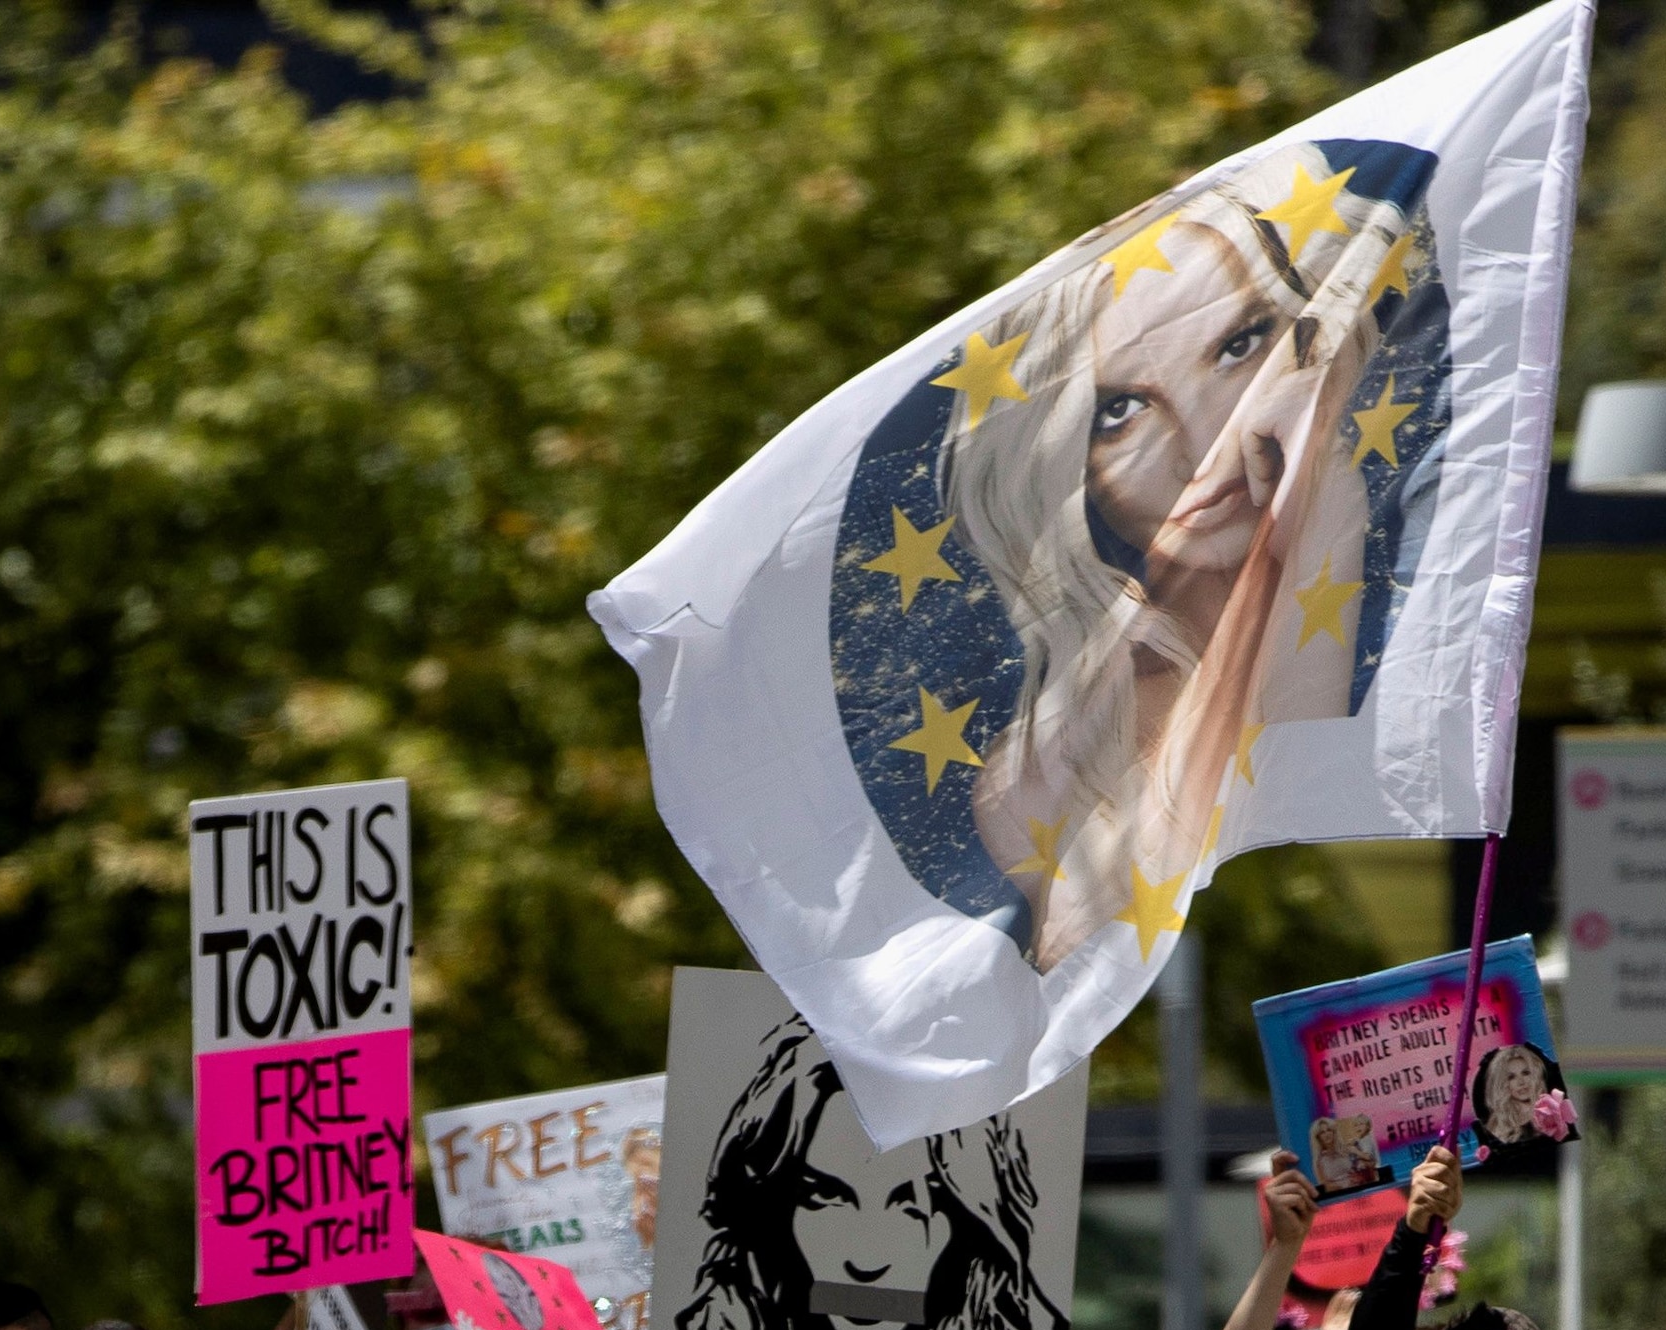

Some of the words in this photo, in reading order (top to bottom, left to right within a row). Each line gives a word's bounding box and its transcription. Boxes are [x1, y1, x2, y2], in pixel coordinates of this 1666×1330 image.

[195, 808, 329, 915] THIS
[345, 804, 398, 908] IS
[200, 902, 404, 1040] TOXIC!
[1314, 1018, 1380, 1051] BRITNEY
[1389, 998, 1451, 1031] SPEARS
[1320, 1038, 1391, 1079] CAPABLE
[1400, 1027, 1448, 1052] ADULT
[253, 1050, 366, 1141] FREE
[1323, 1081, 1355, 1103] THE
[1363, 1065, 1423, 1098] RIGHTS
[1434, 1055, 1454, 1077] OF
[208, 1117, 411, 1227] BRITNEY
[433, 1101, 612, 1196] FREE
[250, 1193, 390, 1276] BITCH!
